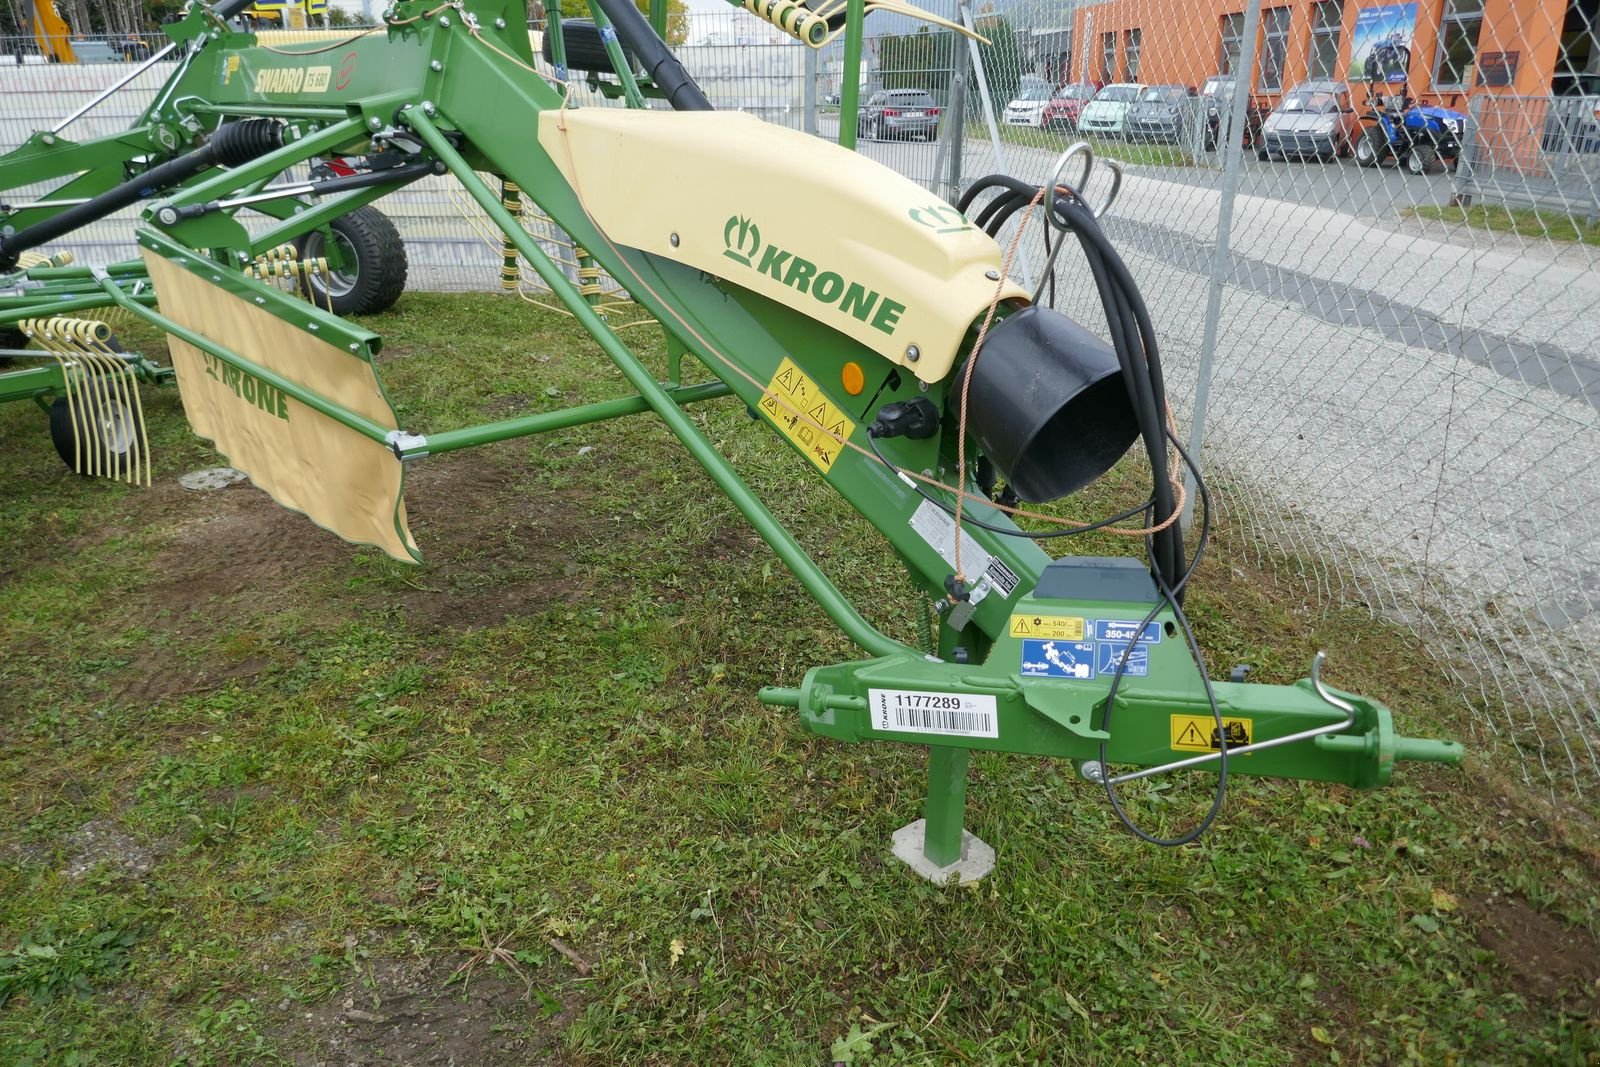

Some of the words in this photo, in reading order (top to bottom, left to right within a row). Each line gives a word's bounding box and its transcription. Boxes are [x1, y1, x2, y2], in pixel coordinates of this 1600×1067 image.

[254, 67, 304, 93] SWADRO
[756, 244, 907, 336] KRONE
[221, 360, 290, 423] KRONE
[930, 508, 952, 528] KRONE
[1052, 630, 1065, 638] 200
[881, 693, 889, 721] KRONE
[895, 694, 961, 710] 1177289
